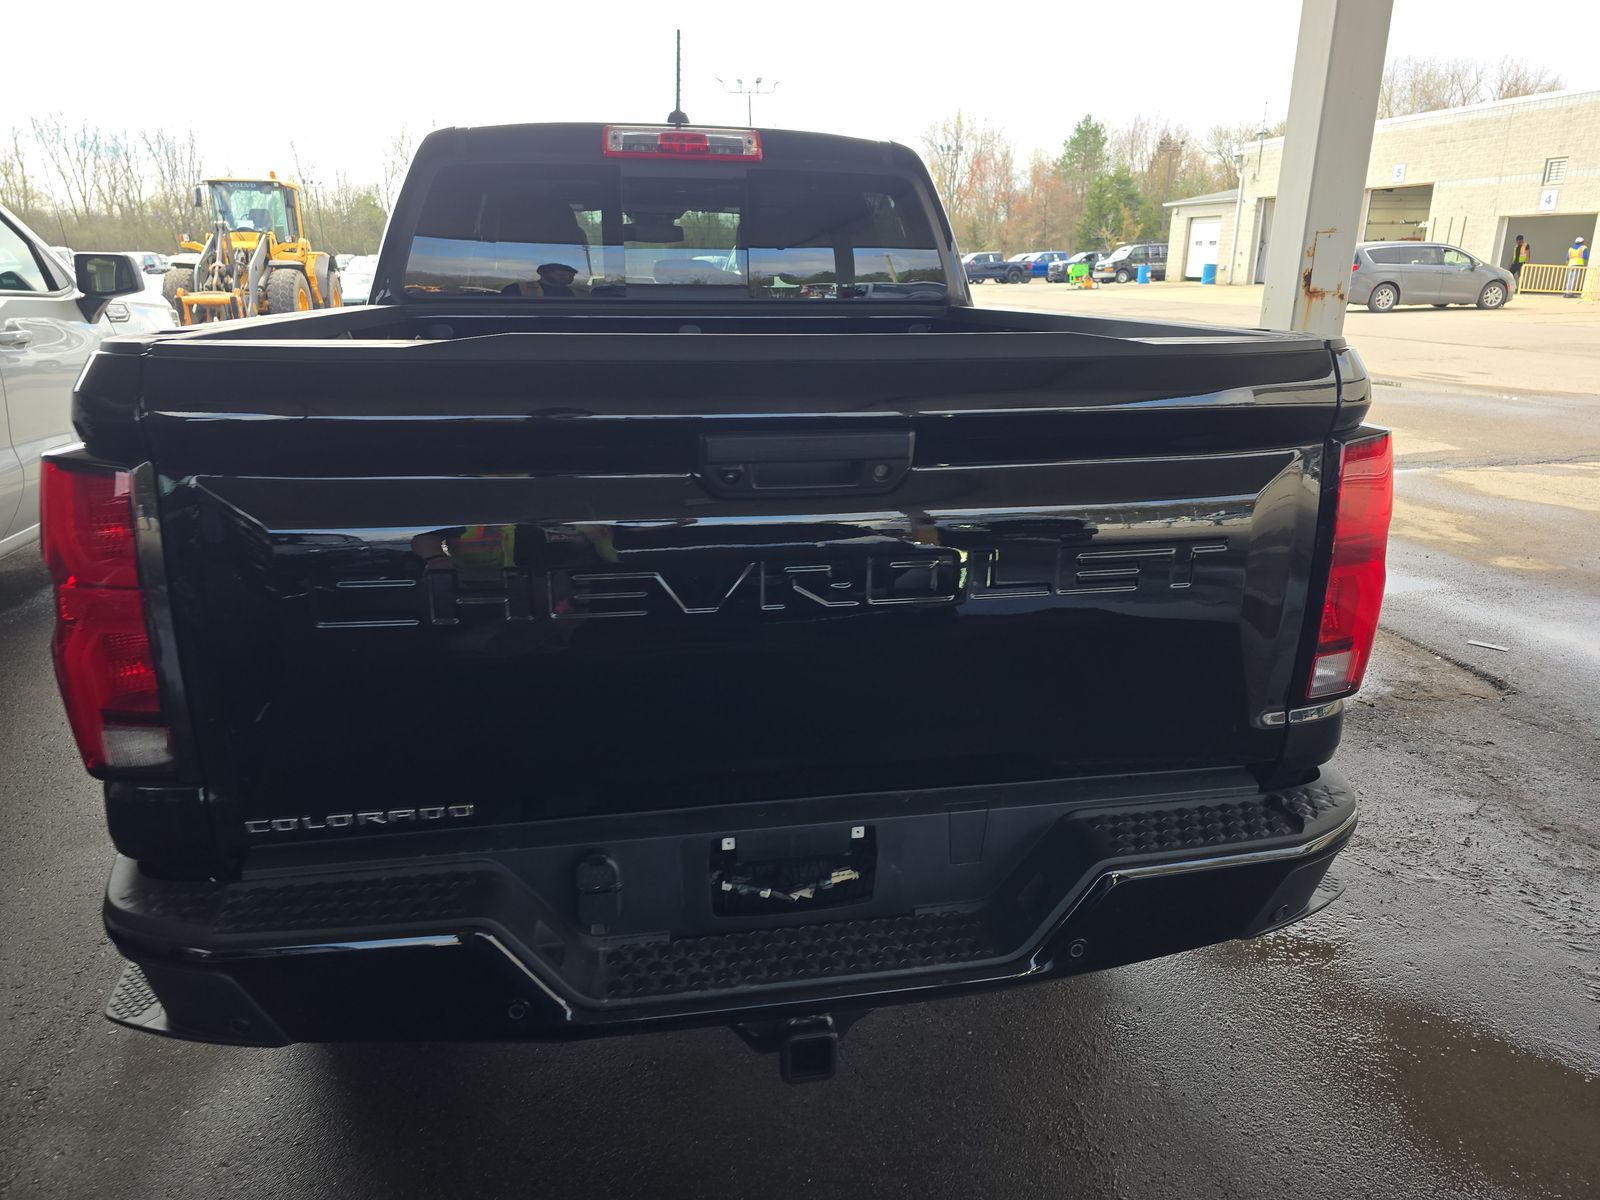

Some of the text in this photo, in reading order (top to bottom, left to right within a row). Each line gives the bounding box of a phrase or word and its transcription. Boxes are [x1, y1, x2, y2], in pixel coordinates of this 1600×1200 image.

[1396, 167, 1402, 178] 5
[1544, 194, 1552, 205] 4
[312, 537, 1229, 629] CHEVROLET
[243, 803, 475, 834] COLORADO
